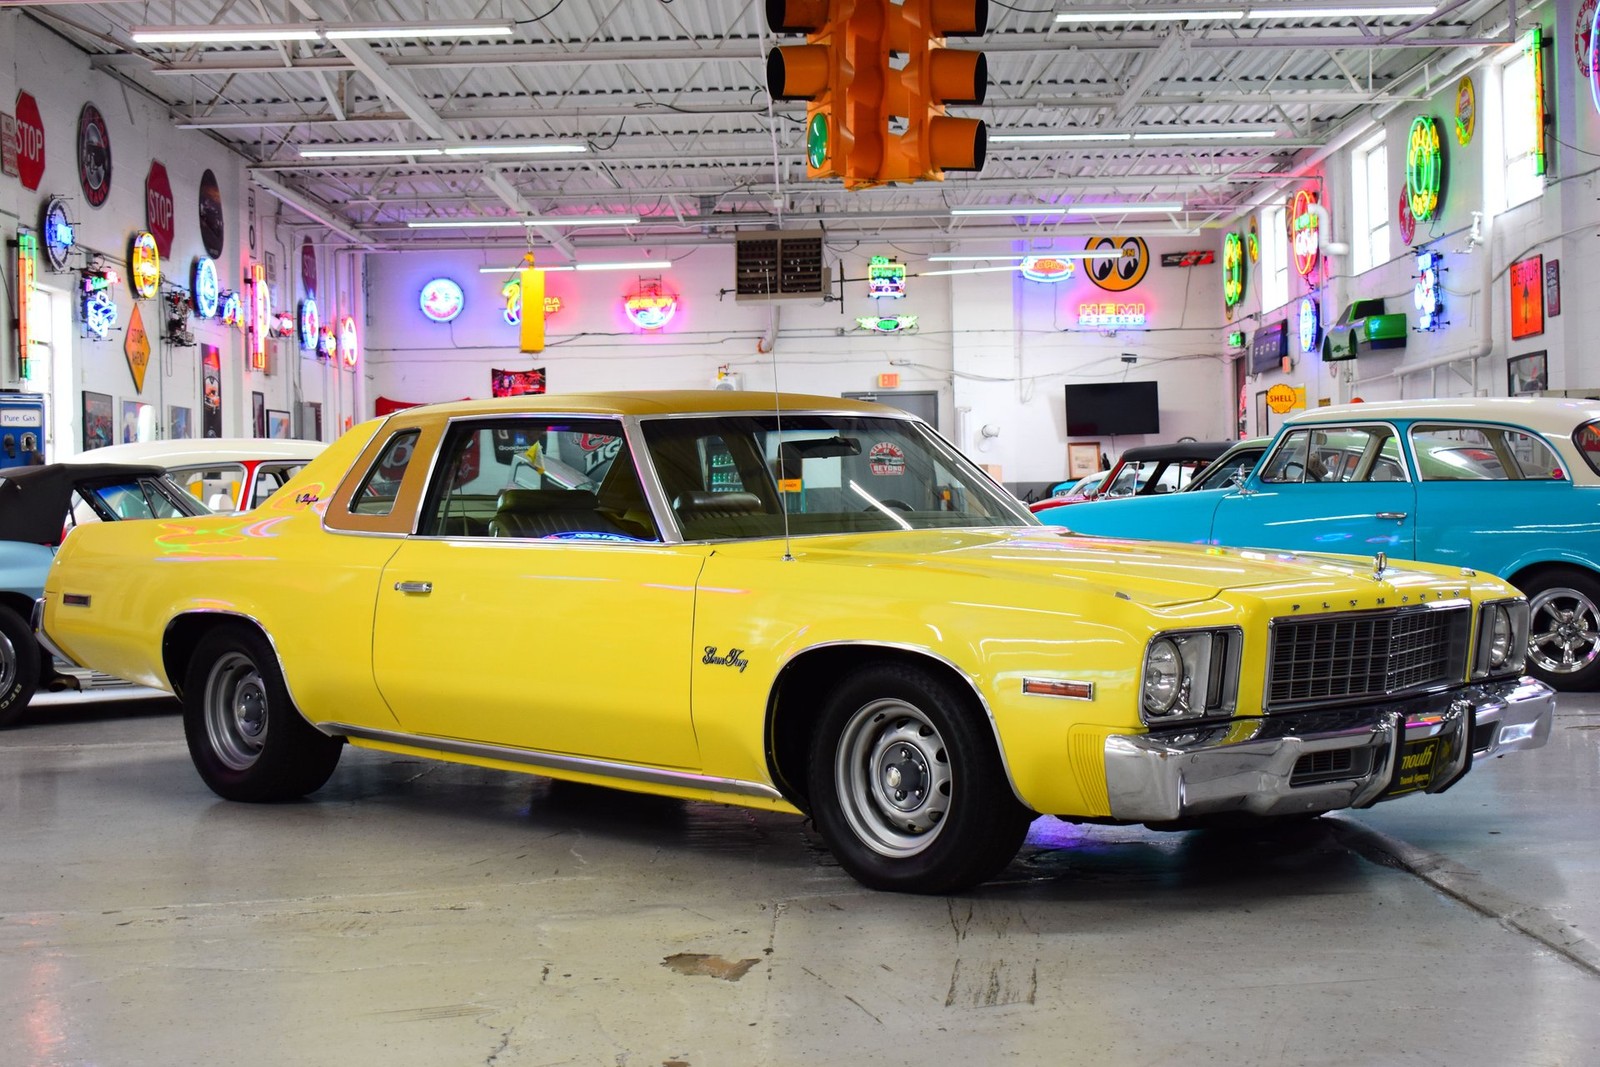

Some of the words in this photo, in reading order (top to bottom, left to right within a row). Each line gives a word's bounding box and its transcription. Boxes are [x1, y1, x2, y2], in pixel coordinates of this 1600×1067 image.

[16, 120, 43, 162] STOP
[150, 190, 172, 228] STOP
[1512, 262, 1539, 286] DETOUR
[1080, 303, 1145, 315] HEMI
[131, 327, 144, 344] STOP
[1255, 341, 1277, 357] FORD
[1270, 394, 1292, 403] SHELL
[584, 437, 619, 475] LIG
[873, 464, 903, 473] BEYOND
[1292, 589, 1460, 611] PLYMOUTH
